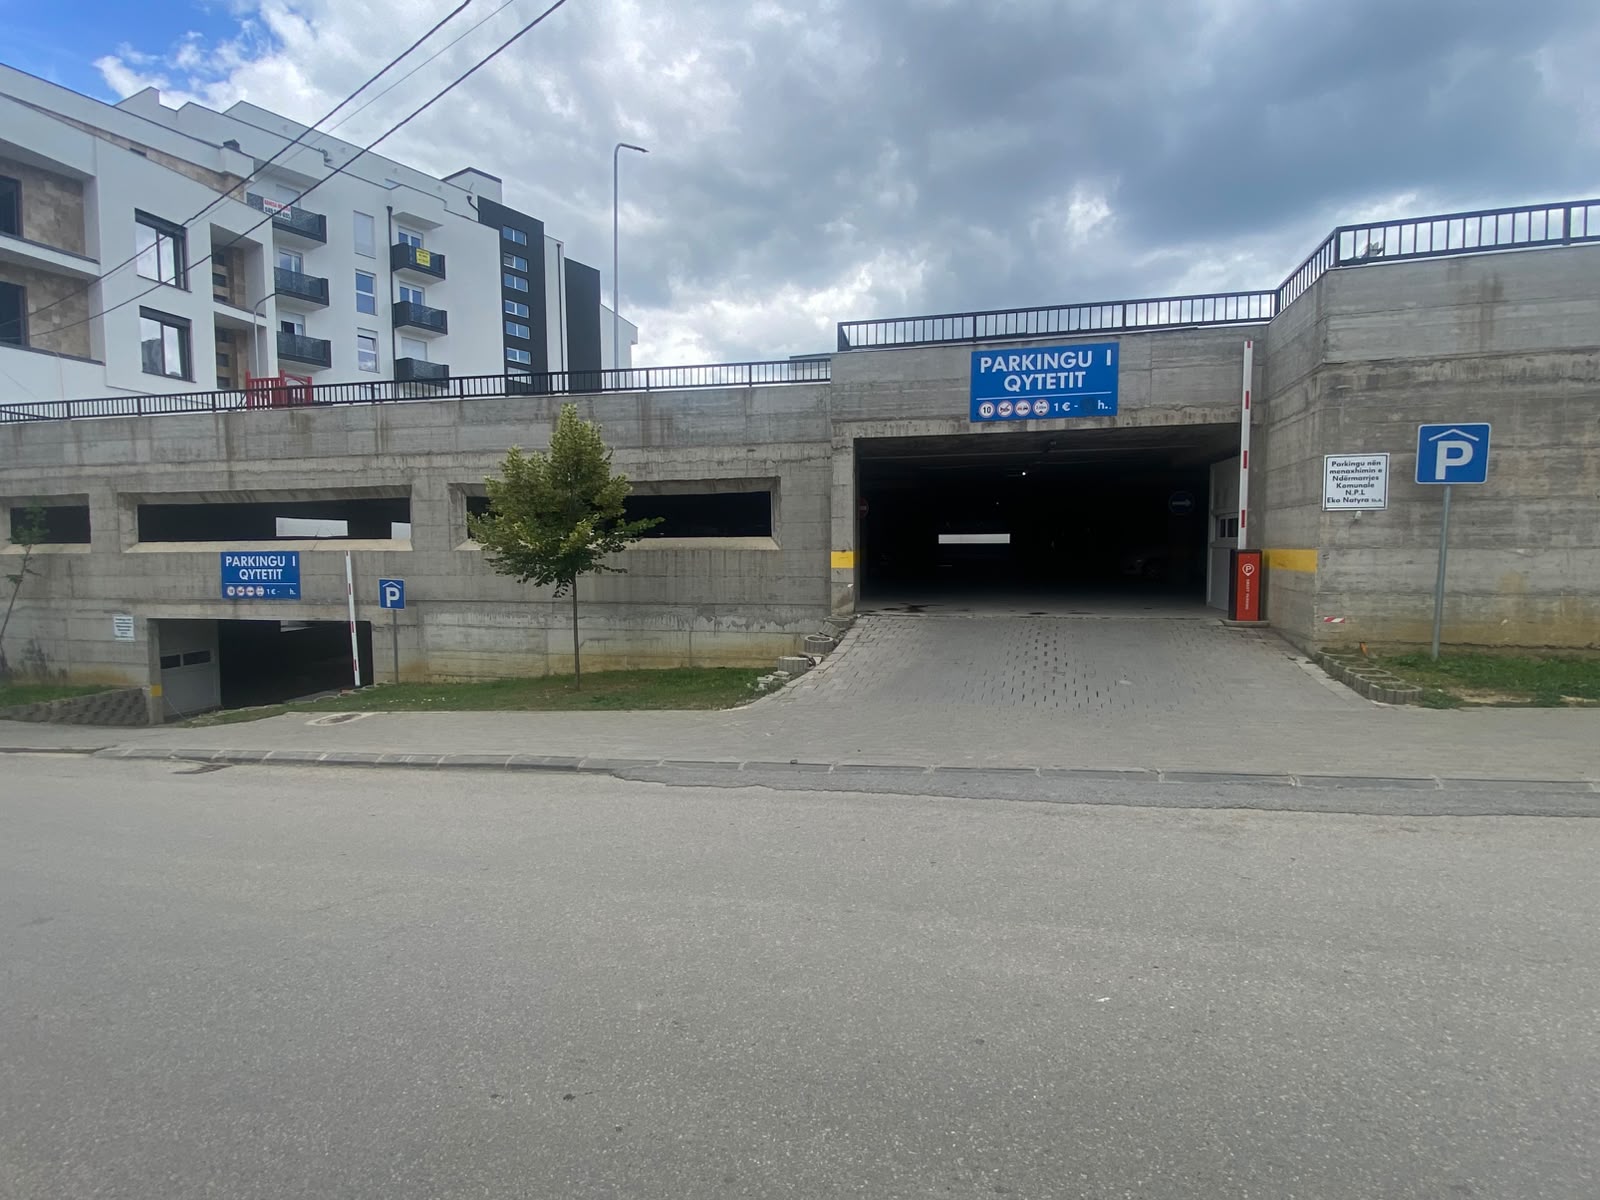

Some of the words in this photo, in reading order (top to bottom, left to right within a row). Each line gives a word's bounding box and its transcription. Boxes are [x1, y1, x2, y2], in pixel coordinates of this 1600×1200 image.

[980, 350, 1093, 374] PARKINGU
[1106, 349, 1112, 366] I
[1003, 371, 1086, 392] QYTETIT
[1053, 402, 1059, 411] 1
[1435, 440, 1474, 480] P
[1343, 496, 1370, 504] Natyra
[225, 555, 286, 567] PARKINGU
[292, 555, 296, 567] I
[239, 568, 283, 581] QYTETIT
[385, 586, 400, 608] P
